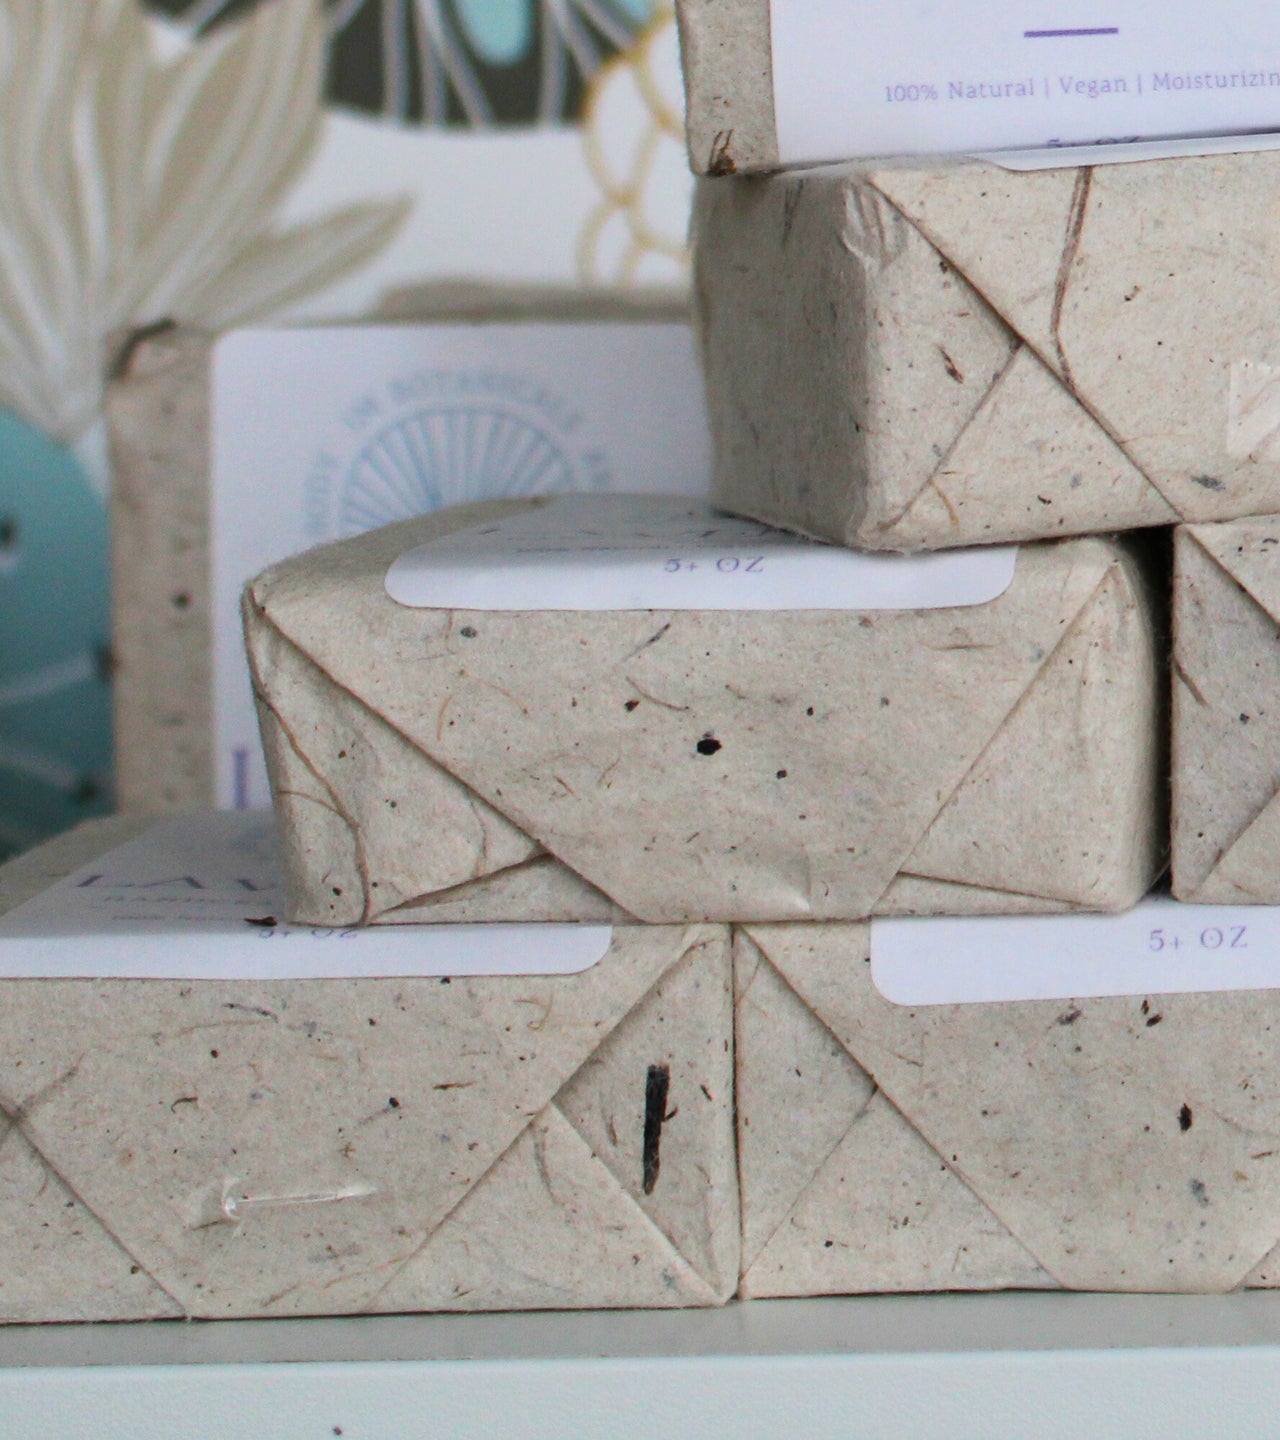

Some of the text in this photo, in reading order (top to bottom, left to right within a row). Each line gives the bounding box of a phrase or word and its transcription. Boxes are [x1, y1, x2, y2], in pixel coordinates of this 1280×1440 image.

[884, 83, 939, 103] 100%
[947, 78, 1036, 101] Natural
[1058, 75, 1128, 99] Vegan
[716, 556, 765, 573] OZ
[1199, 925, 1248, 950] OZ
